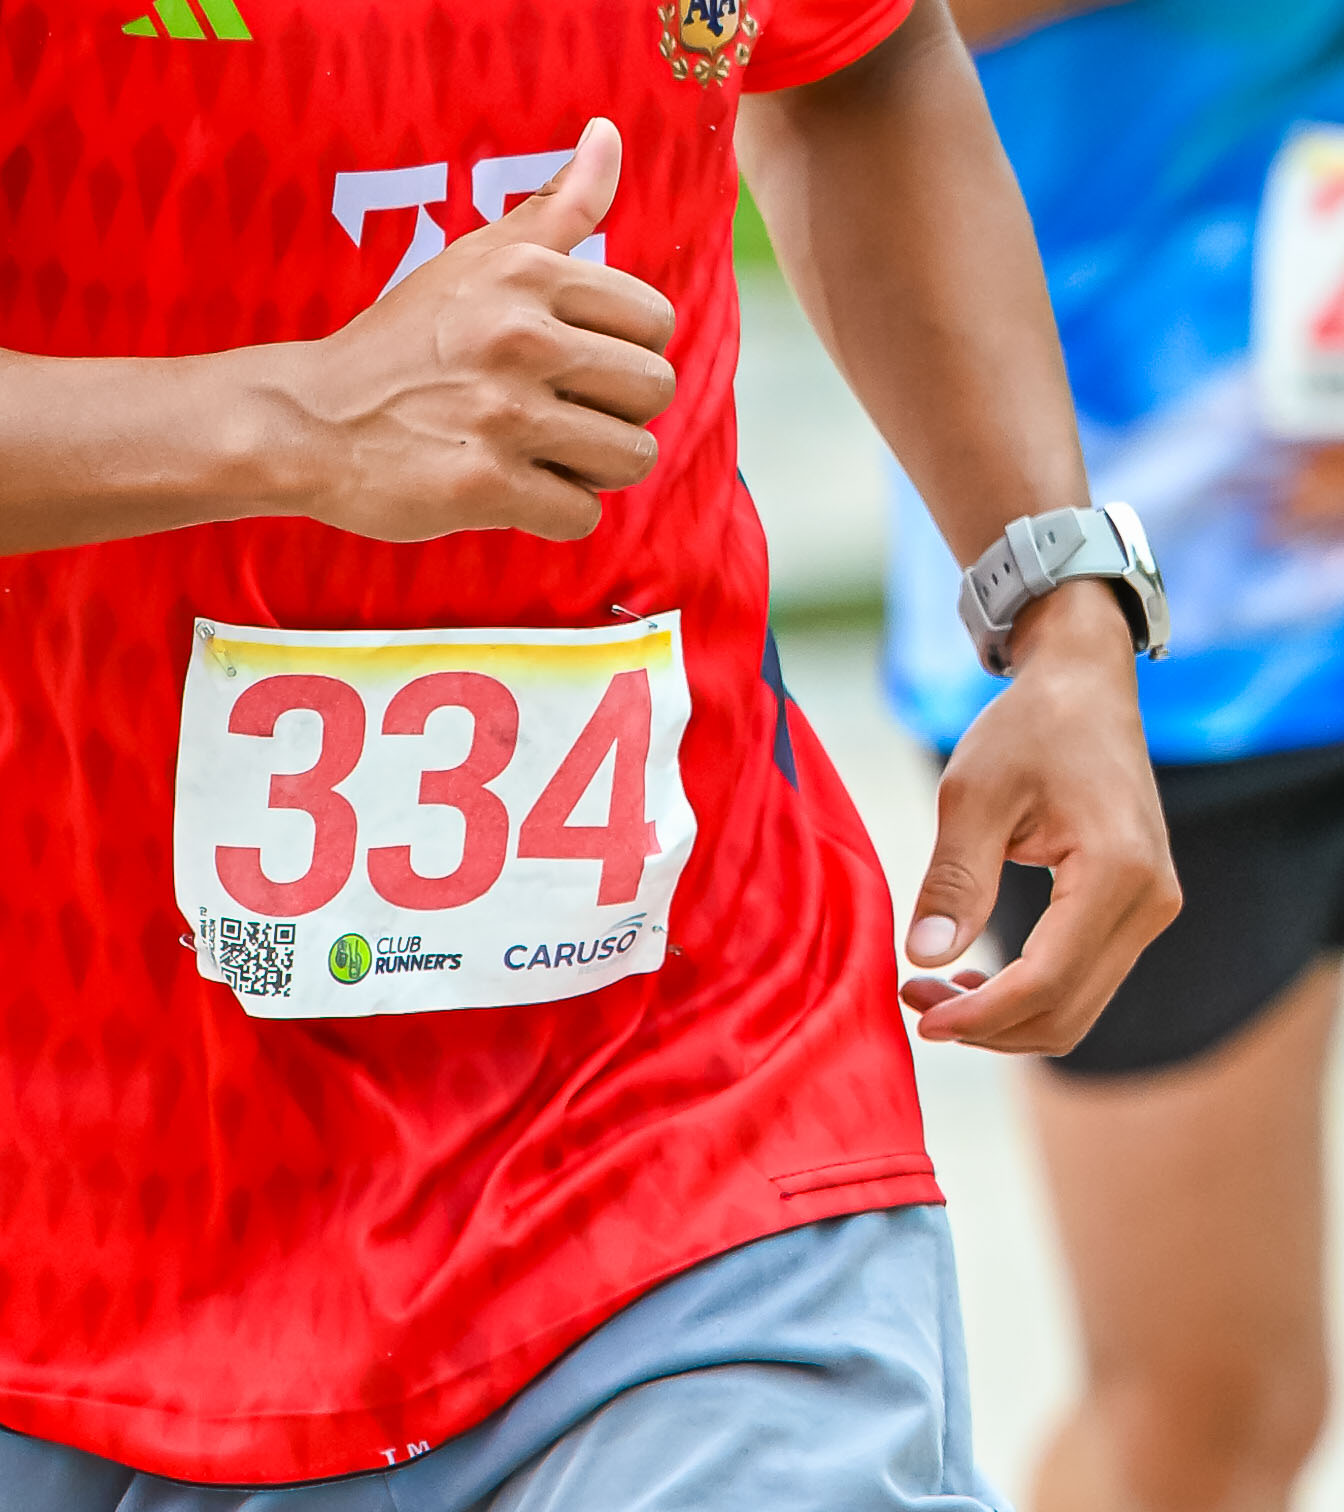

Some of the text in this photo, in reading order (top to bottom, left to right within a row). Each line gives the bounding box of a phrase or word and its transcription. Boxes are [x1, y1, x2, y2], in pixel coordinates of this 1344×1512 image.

[214, 667, 663, 918] 334
[377, 936, 422, 955] CLUB
[504, 929, 637, 970] CARUSO
[375, 954, 463, 974] RUNNER'S
